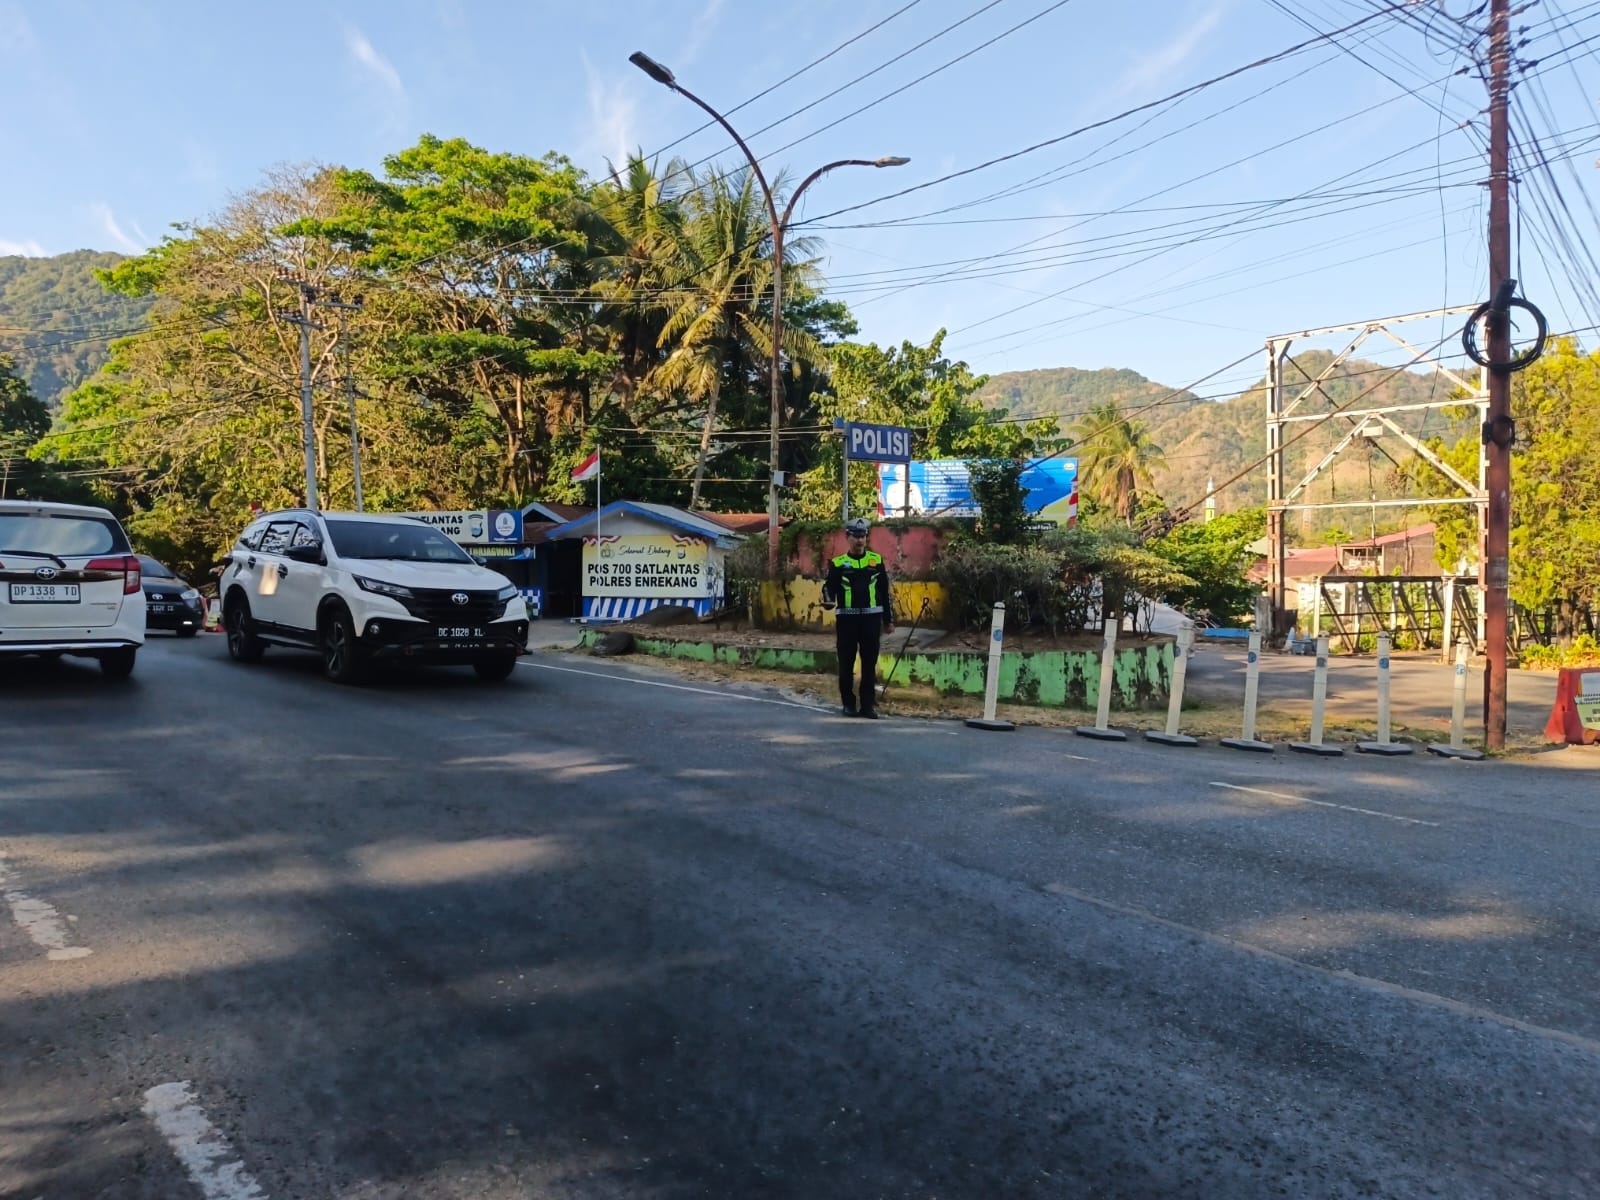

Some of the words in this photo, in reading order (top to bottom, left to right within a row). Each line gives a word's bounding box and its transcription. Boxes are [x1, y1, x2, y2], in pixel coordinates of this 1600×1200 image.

[852, 428, 909, 456] POLISI
[618, 544, 645, 556] Selamat
[648, 545, 671, 557] Datang
[588, 564, 609, 574] POS
[612, 564, 632, 574] 700
[635, 564, 700, 575] SATLANTAS
[590, 576, 632, 587] POLRES
[635, 576, 697, 588] ENREKANG
[14, 586, 27, 596] DP
[29, 586, 56, 596] 1338
[438, 627, 449, 637] DC
